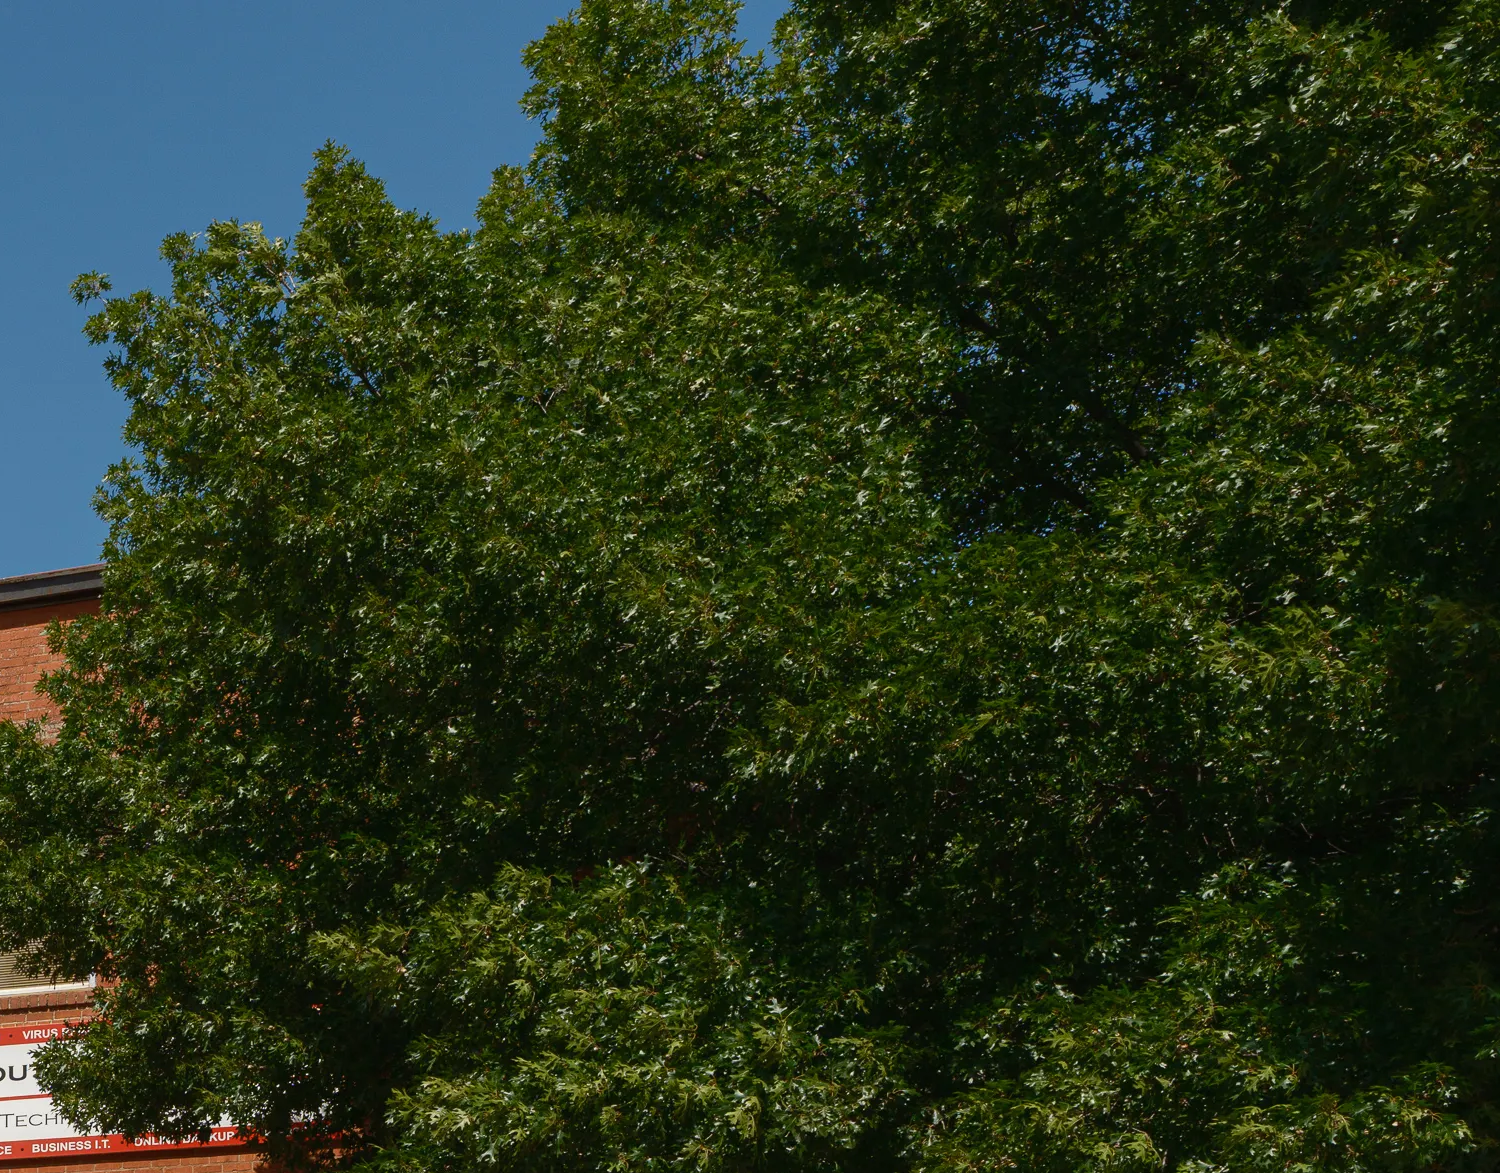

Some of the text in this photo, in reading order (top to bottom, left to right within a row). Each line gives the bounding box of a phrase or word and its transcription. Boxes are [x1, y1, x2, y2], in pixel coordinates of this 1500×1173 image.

[22, 1028, 58, 1040] VIRUS
[32, 1140, 92, 1153] BUSINESS
[95, 1139, 111, 1150] I.T.
[183, 1131, 235, 1144] BAKUP
